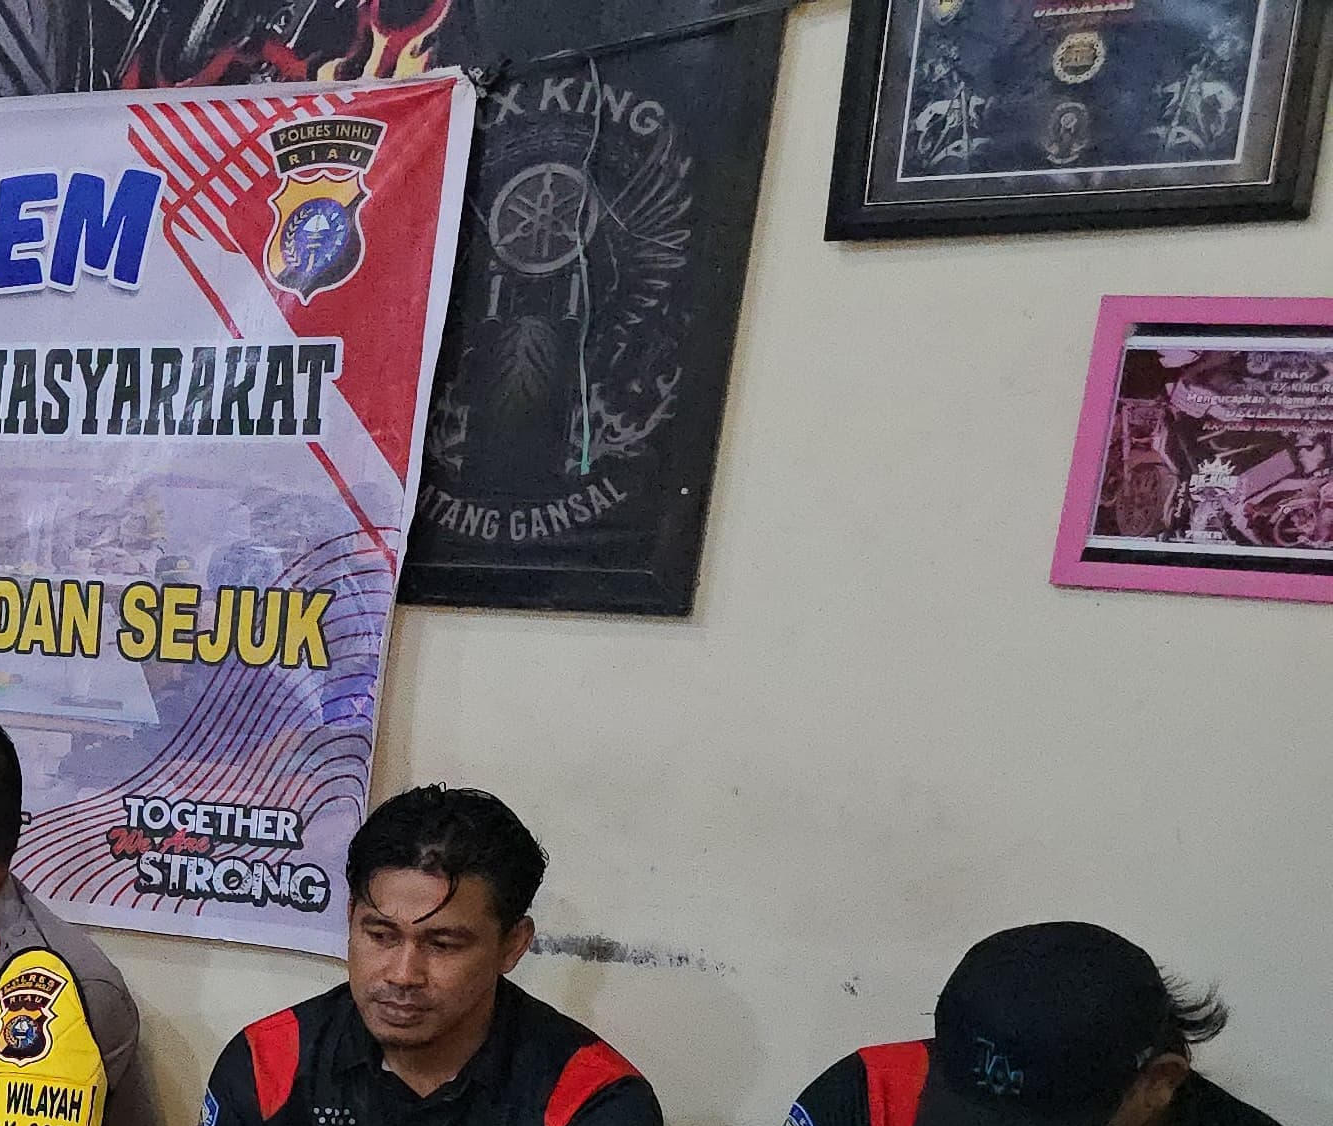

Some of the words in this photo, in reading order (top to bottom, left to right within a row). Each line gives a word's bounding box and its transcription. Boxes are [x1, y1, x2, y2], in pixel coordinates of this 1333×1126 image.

[539, 77, 666, 136] KING
[278, 125, 331, 145] POLRES
[335, 124, 372, 140] INHU
[288, 148, 362, 165] RIAU
[418, 484, 501, 540] ATANG
[509, 477, 628, 541] GANSAL
[116, 583, 337, 670] SEJUK
[109, 828, 152, 854] We
[160, 828, 211, 854] Are
[124, 796, 299, 843] TOGETHER
[139, 850, 328, 905] STRONG
[7, 1081, 83, 1123] WILAYAH
